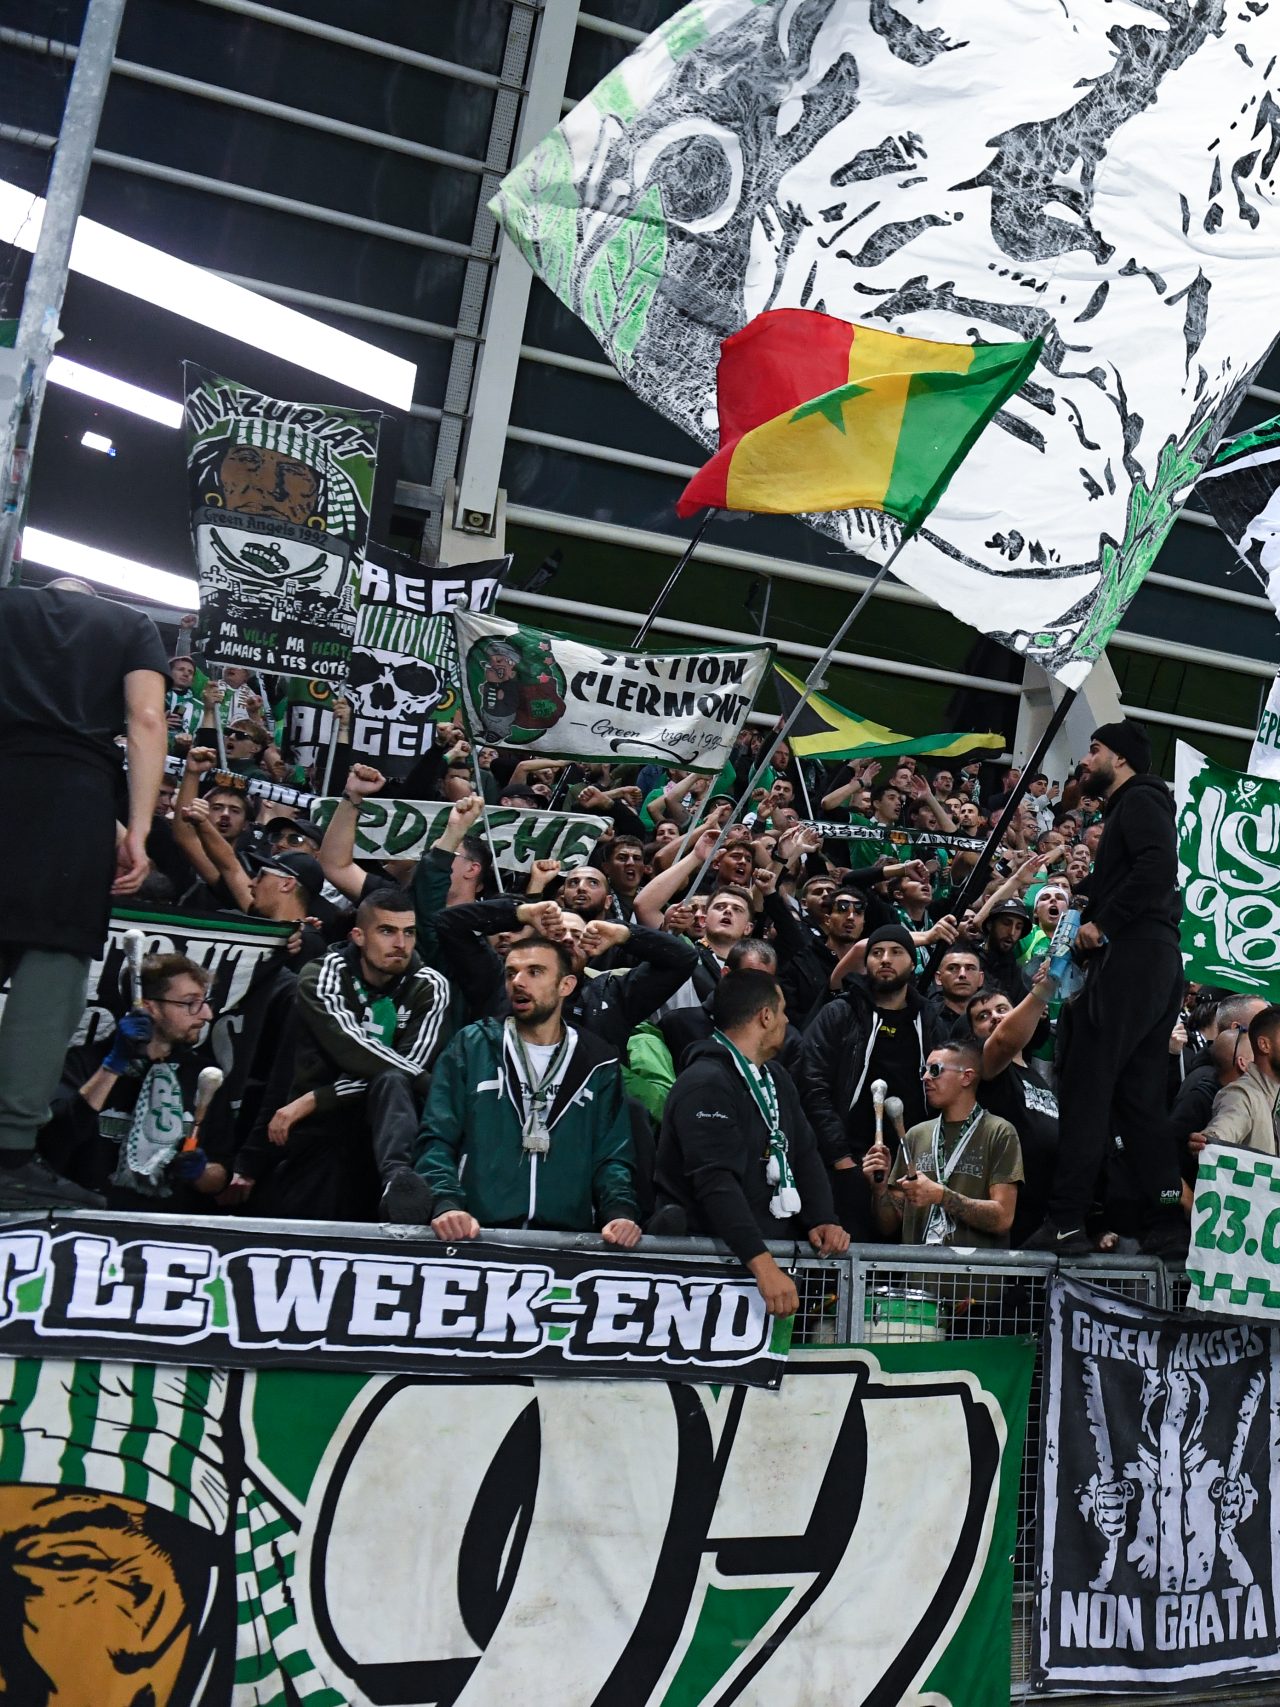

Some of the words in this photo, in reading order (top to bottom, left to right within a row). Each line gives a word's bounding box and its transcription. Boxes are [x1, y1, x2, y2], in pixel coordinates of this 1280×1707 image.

[187, 386, 377, 460] MAZURIAT
[248, 516, 295, 537] Angels
[300, 528, 328, 547] 1992
[214, 640, 262, 662] JAMAIS
[281, 654, 307, 670] TES
[220, 622, 238, 638] MA
[286, 636, 305, 653] MA
[570, 671, 751, 726] CLERMONT
[591, 719, 641, 738] Green
[67, 1237, 210, 1328] LE
[246, 1254, 768, 1359] WEEK-END
[1071, 1310, 1160, 1369] GREEN
[1060, 1590, 1145, 1652] NON
[1156, 1584, 1268, 1652] GRATA
